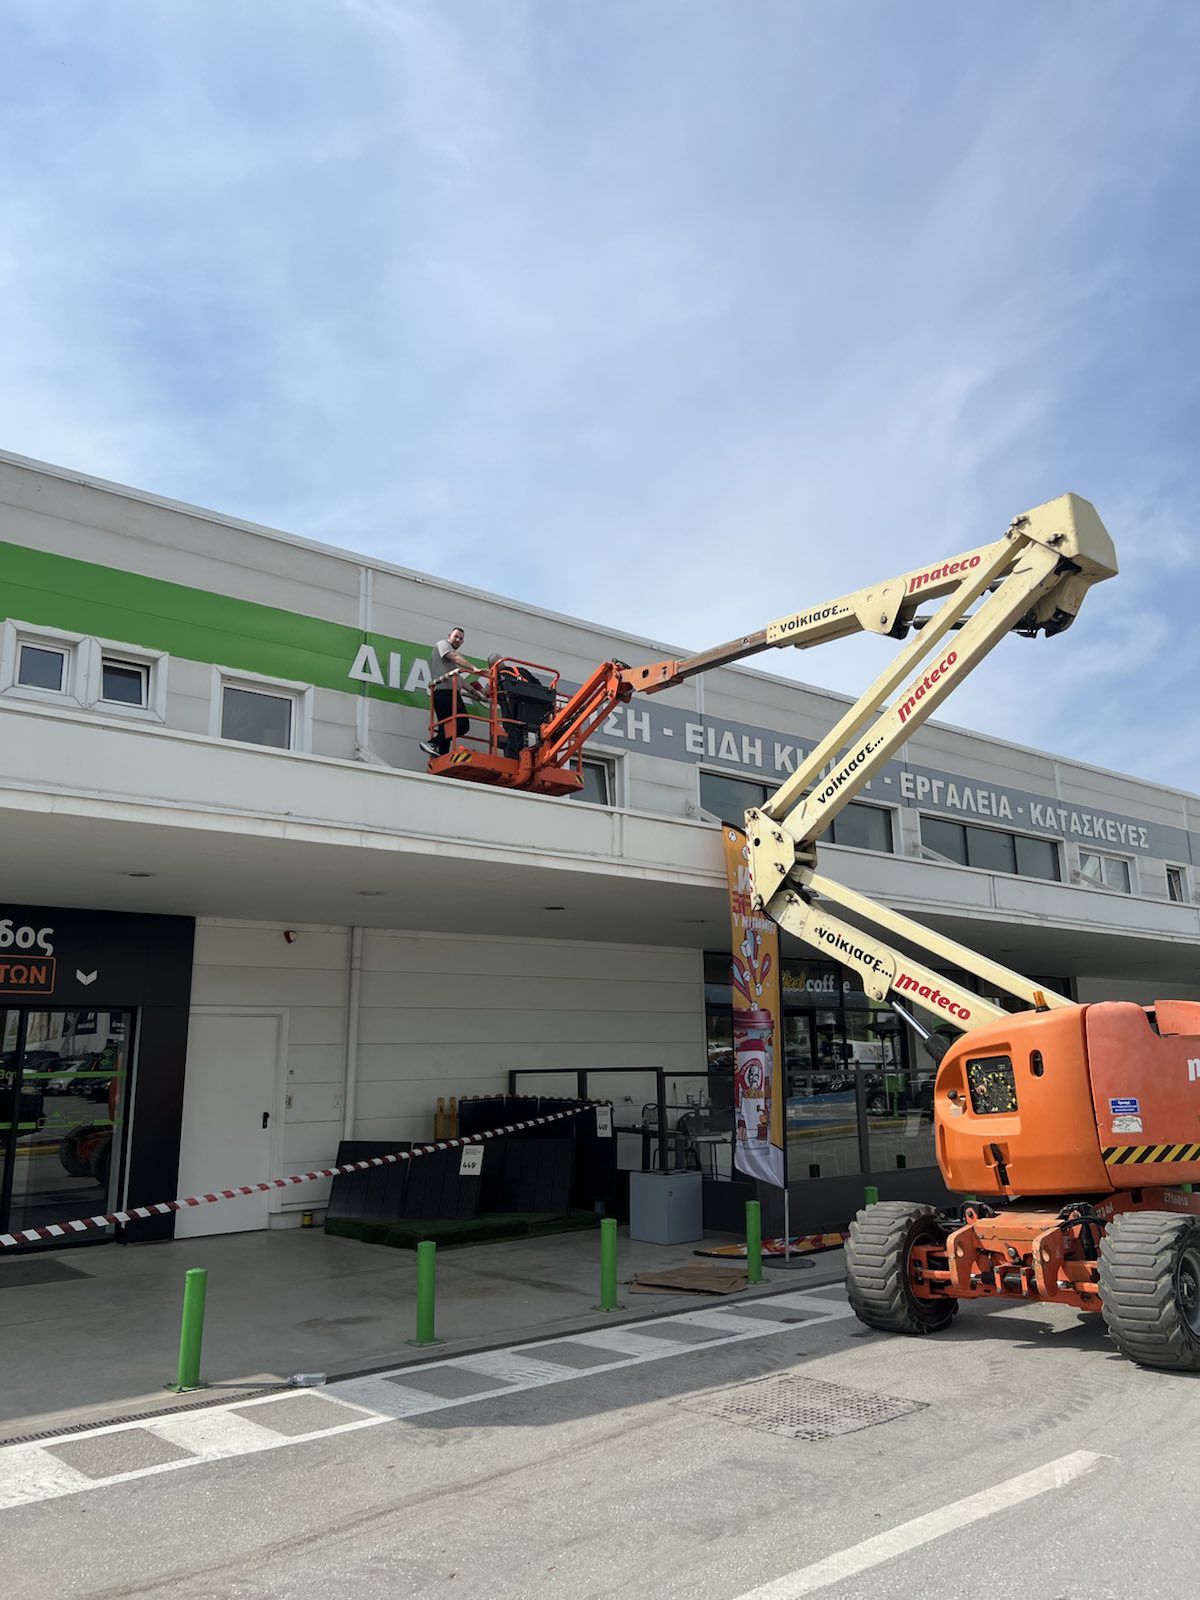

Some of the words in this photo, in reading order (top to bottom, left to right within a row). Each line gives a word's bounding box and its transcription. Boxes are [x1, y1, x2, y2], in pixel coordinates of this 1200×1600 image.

[908, 555, 981, 594] mateco
[898, 651, 958, 724] mateco
[685, 722, 762, 767] ΕΙΔΗ
[900, 771, 1013, 820] ΕΡΓΑΛΕΙΑ
[1029, 802, 1149, 848] ΚΑΤΑΣΚΕΥΕΣ
[895, 973, 971, 1020] mateco
